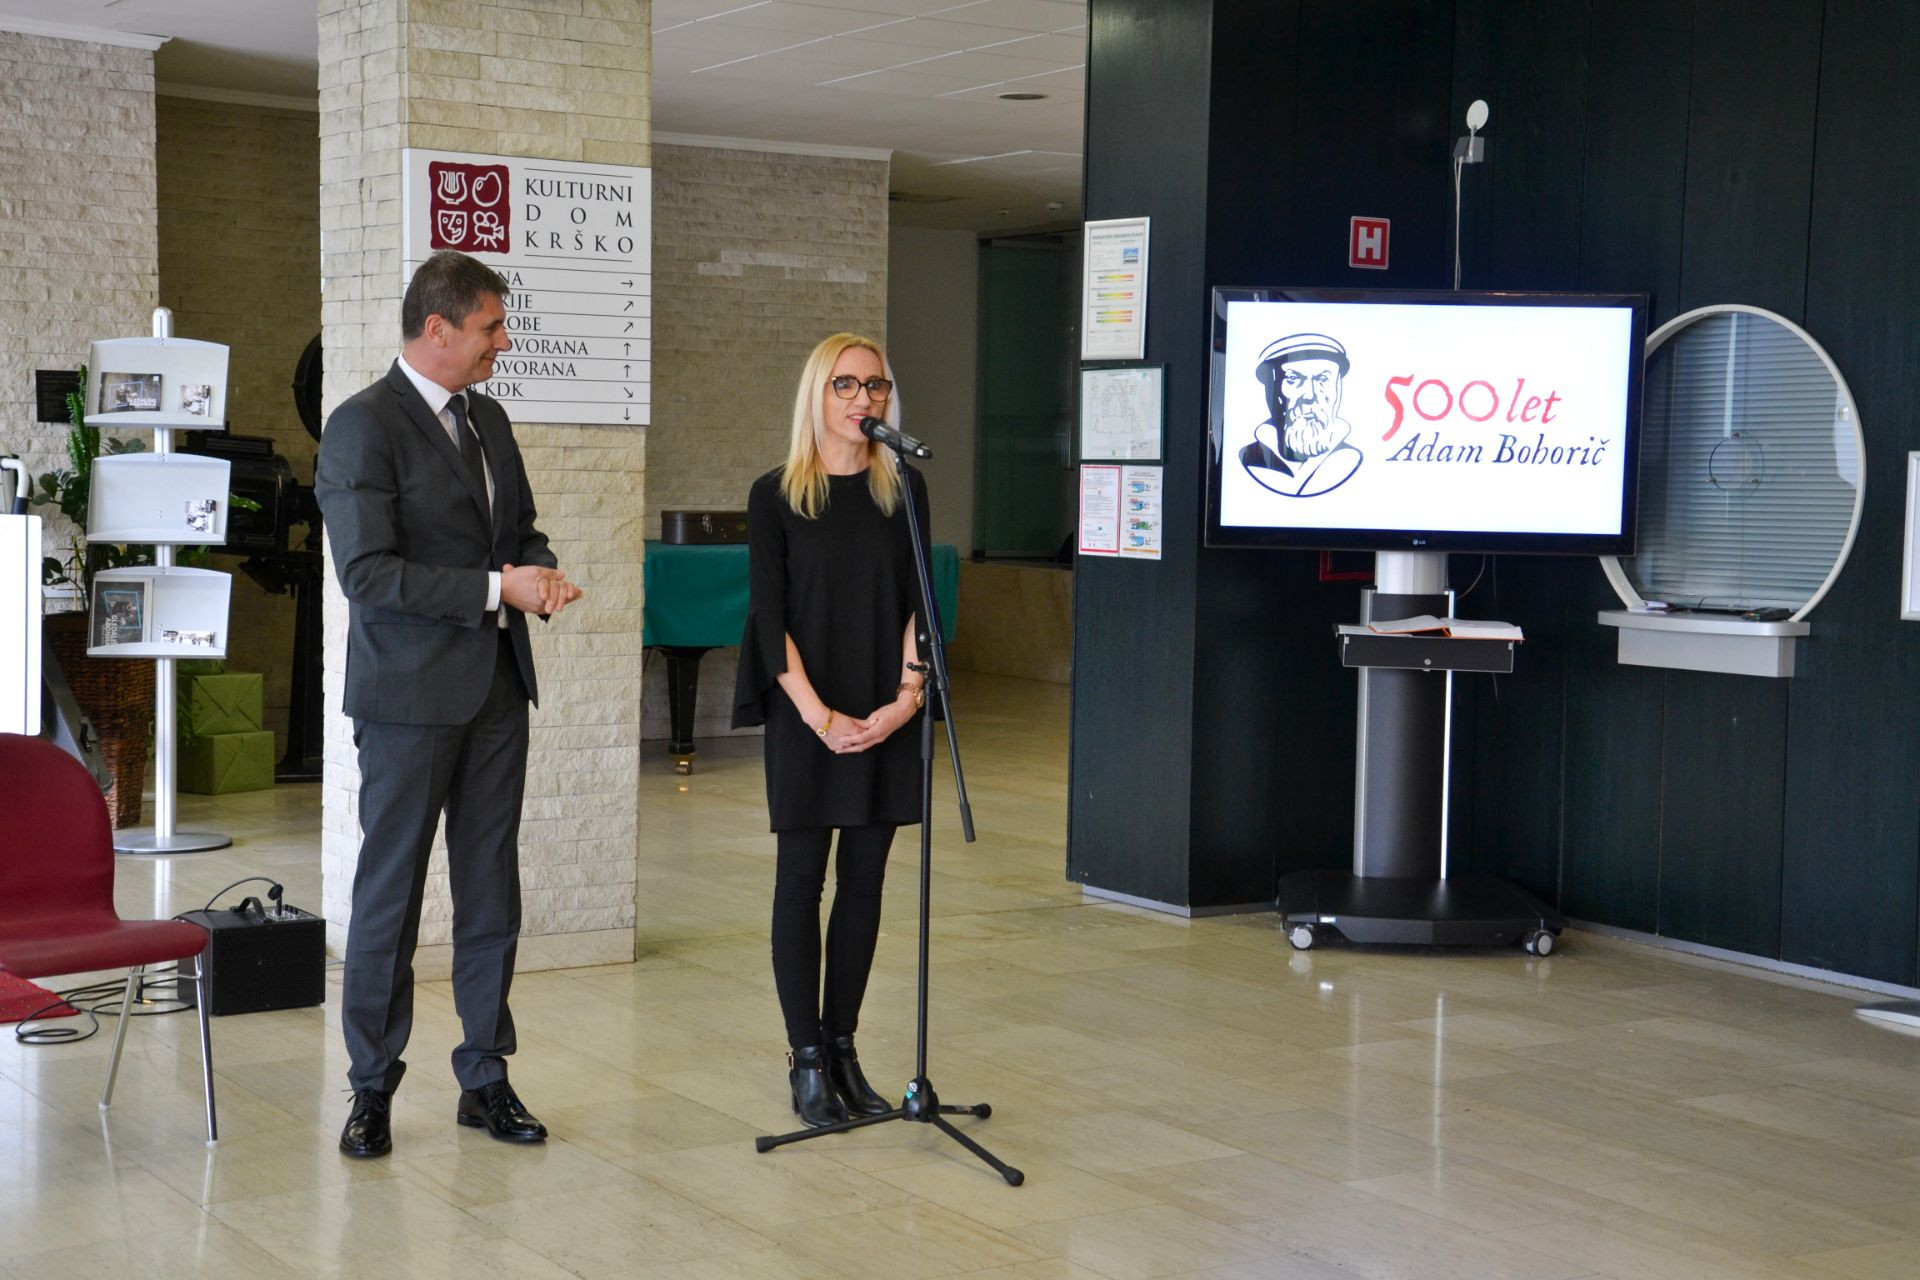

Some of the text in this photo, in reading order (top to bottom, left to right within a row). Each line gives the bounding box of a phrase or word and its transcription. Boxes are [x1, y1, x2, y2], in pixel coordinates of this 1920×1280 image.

[525, 178, 632, 203] KULTURNI
[525, 203, 633, 228] DOM
[525, 229, 634, 254] KRŠKO
[1357, 226, 1382, 260] H
[498, 270, 523, 286] NA
[504, 315, 542, 331] OBE
[484, 382, 524, 398] KDK
[1385, 432, 1611, 466] Adam Bohorič
